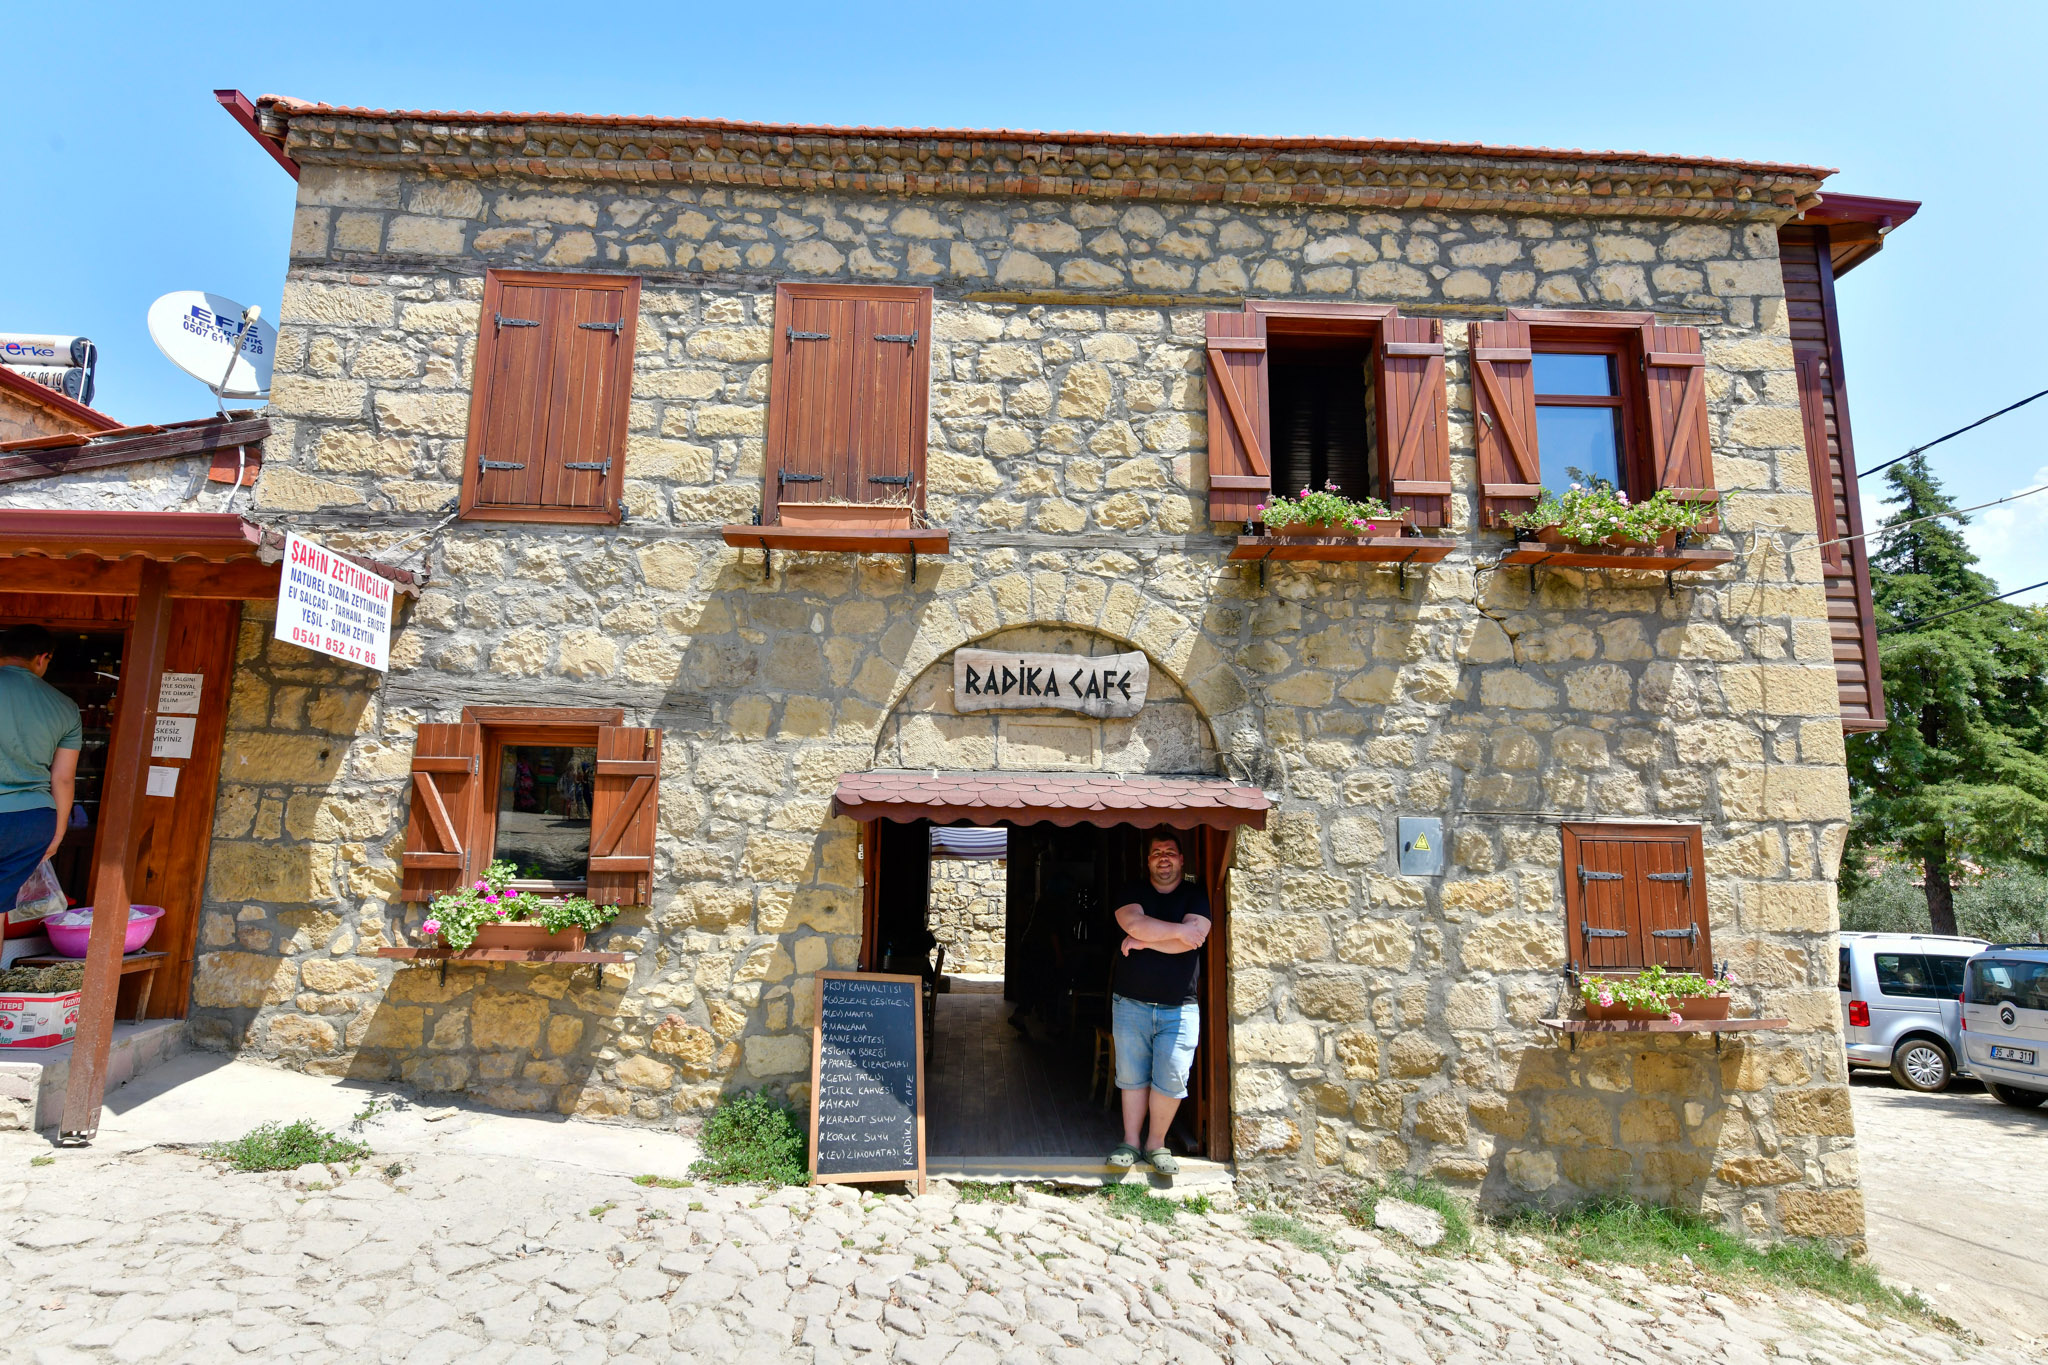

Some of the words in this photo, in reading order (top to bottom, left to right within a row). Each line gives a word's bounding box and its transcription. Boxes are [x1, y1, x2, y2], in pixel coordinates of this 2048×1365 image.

[183, 321, 209, 337] 0507
[211, 333, 231, 345] 611
[250, 344, 263, 355] 28
[191, 305, 258, 338] EFE
[0, 343, 55, 357] erke
[38, 371, 50, 386] 08
[52, 372, 63, 387] 10
[291, 540, 329, 575] ŞAHİN
[331, 558, 390, 602] ZEYTİNCİLİK
[288, 585, 298, 599] EV
[299, 590, 329, 611] SALÇASI
[335, 604, 362, 623] TARHANA
[290, 567, 326, 594] NATUREL
[327, 583, 350, 604] SIZMA
[351, 593, 387, 619] ZEYTİNYAĞI
[302, 607, 323, 628] YEŞİL
[331, 618, 351, 637] SİYAH
[352, 626, 375, 645] ZEYTİN
[292, 626, 320, 647] 0541
[325, 637, 345, 655] 852
[348, 645, 361, 660] 47
[364, 650, 376, 665] 86
[965, 659, 1060, 697] RADİKA
[1068, 668, 1132, 701] CAFE
[828, 1034, 851, 1043] ANNE
[827, 1058, 858, 1070] PATATES
[2006, 1050, 2014, 1058] JR
[2019, 1051, 2032, 1061] 311
[825, 1098, 860, 1110] AYRAN
[904, 1074, 914, 1107] CAFE
[826, 1115, 866, 1125] KARADUT
[826, 1132, 858, 1142] KORUK
[902, 1115, 914, 1166] RADİKA
